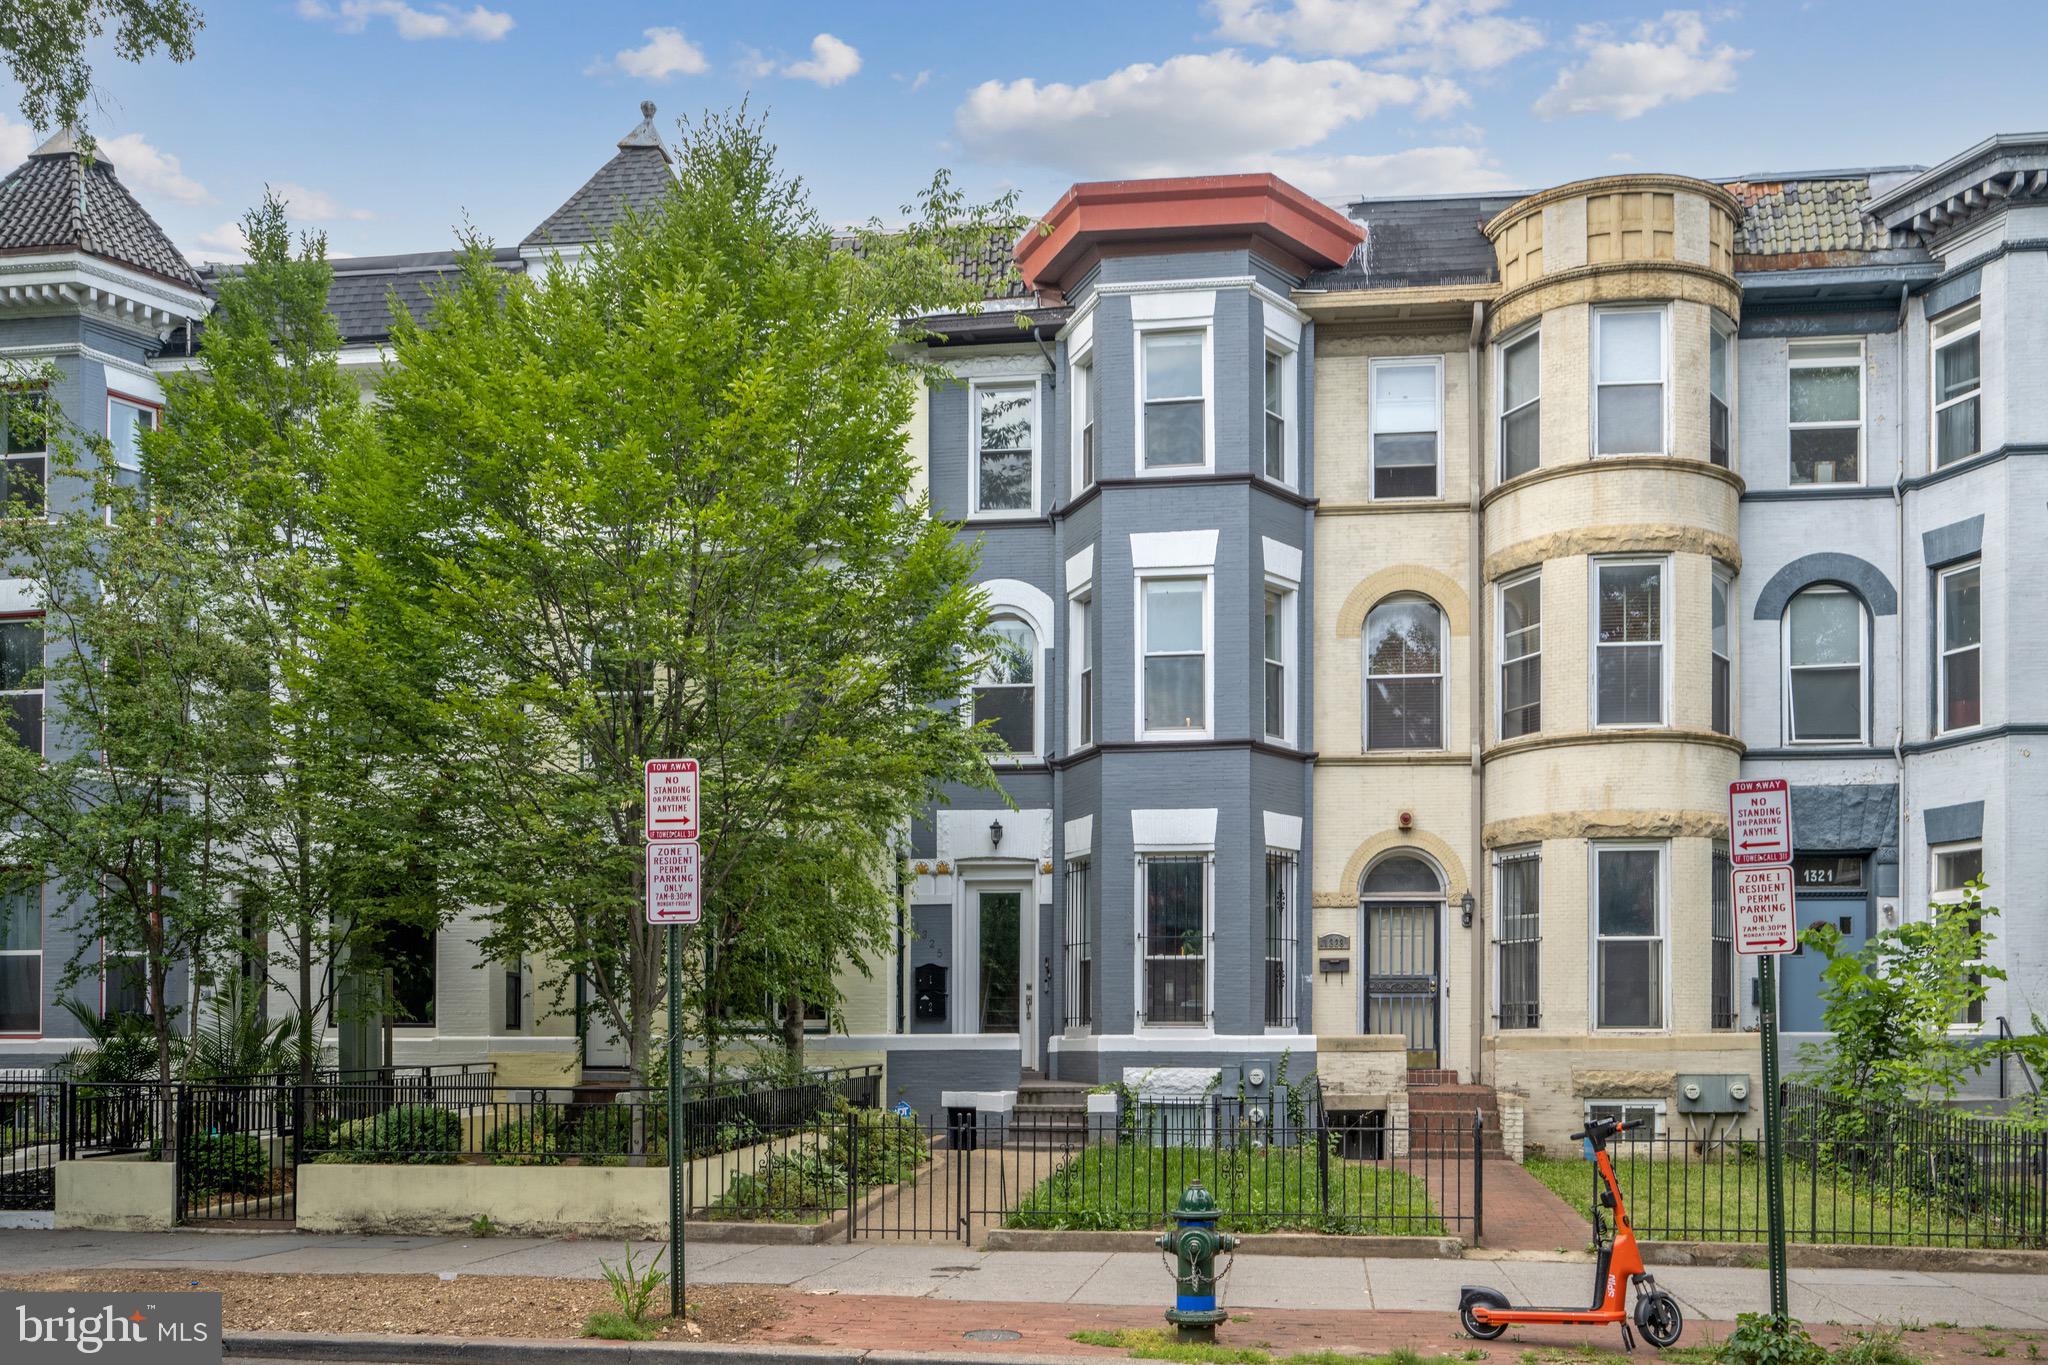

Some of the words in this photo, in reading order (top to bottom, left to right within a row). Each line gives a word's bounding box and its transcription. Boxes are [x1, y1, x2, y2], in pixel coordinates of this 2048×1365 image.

[654, 786, 690, 794] STANDING
[1736, 783, 1752, 791] TOW
[1756, 781, 1780, 789] AWAY
[1751, 798, 1766, 806] NO
[1738, 807, 1781, 818] STANDING
[1749, 817, 1782, 825] PARKING
[1743, 827, 1778, 837] ANYTIME
[658, 848, 682, 856] ZONE
[1743, 854, 1760, 862] TOWED
[654, 874, 693, 882] PARKING
[1745, 873, 1772, 883] ZONE
[1777, 873, 1780, 881] 1
[1803, 870, 1832, 882] 1321
[664, 884, 682, 892] ONLY
[1739, 883, 1785, 893] RESIDENT
[1747, 894, 1779, 903] PERMIT
[1740, 904, 1786, 913] PARKING
[1753, 915, 1774, 923] ONLY
[1607, 1274, 1616, 1298] SPIN
